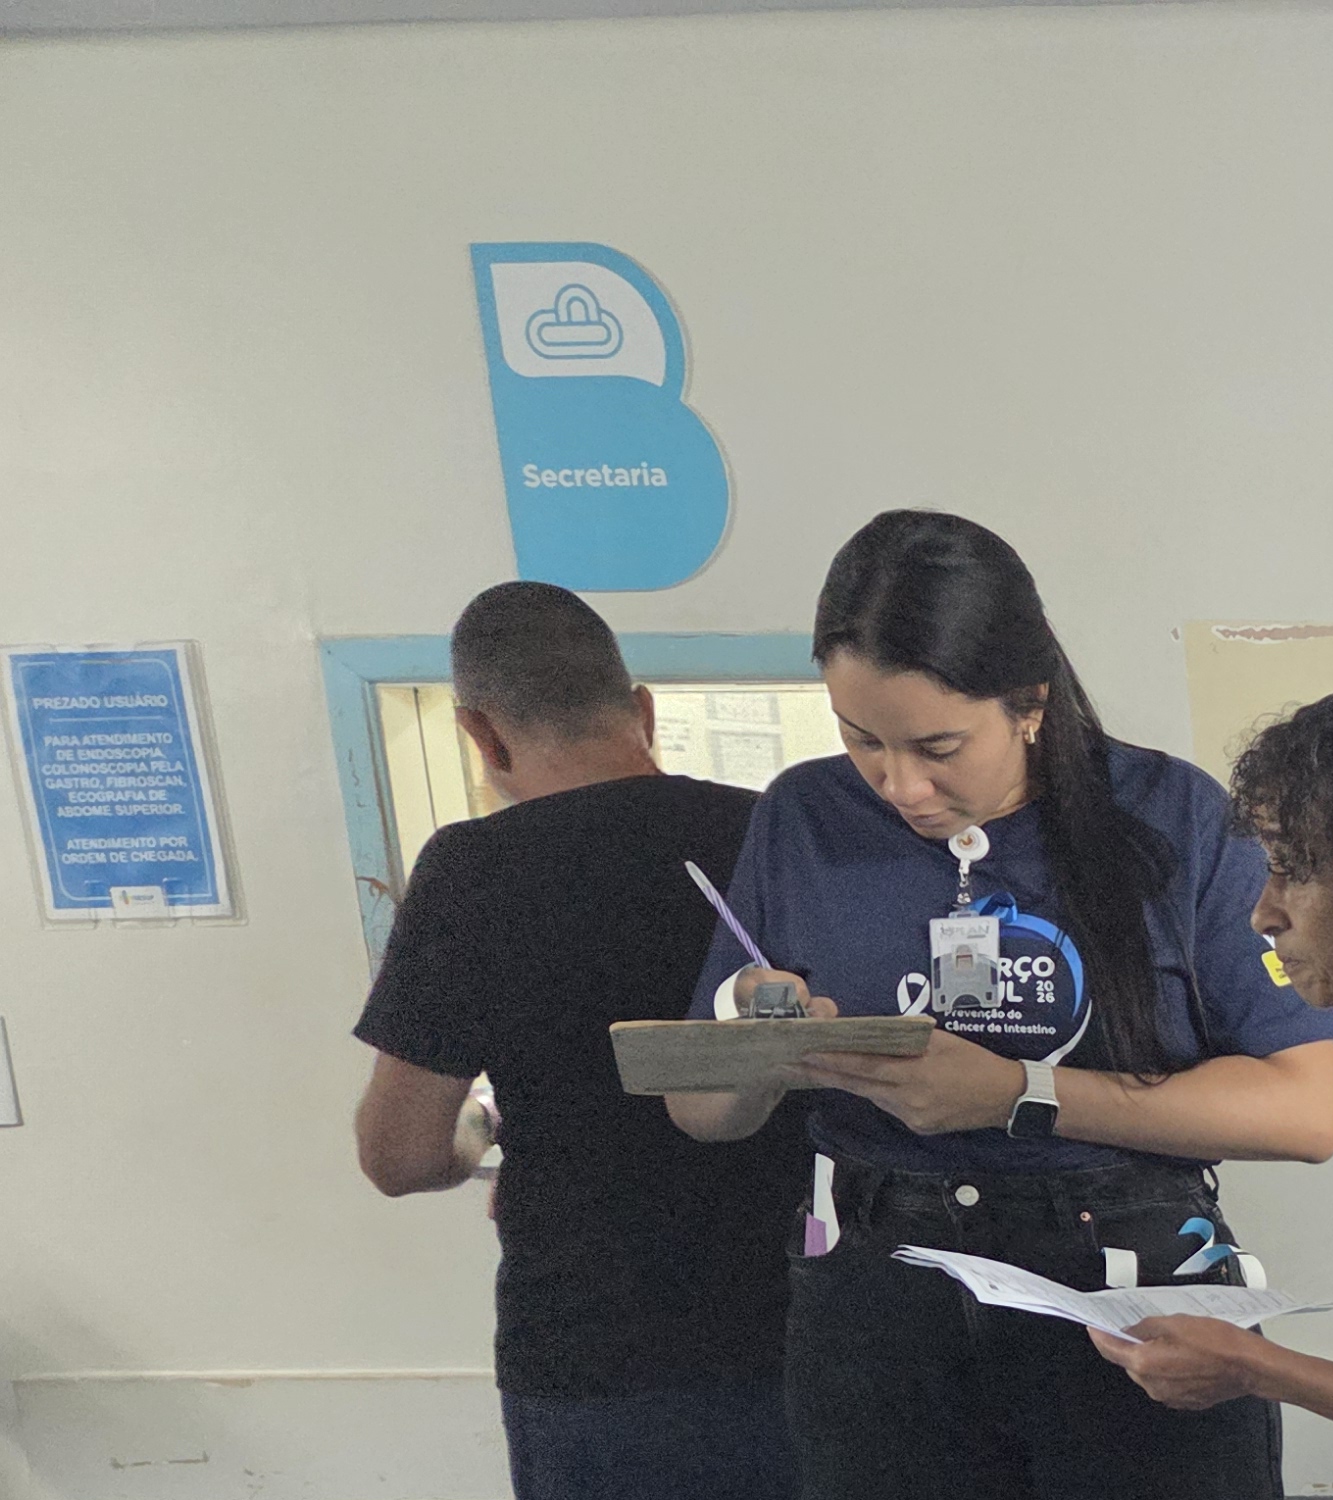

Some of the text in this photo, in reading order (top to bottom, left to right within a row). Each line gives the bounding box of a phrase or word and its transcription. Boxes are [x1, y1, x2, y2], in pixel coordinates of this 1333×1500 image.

[521, 461, 668, 488] Secretaria
[32, 696, 100, 710] PREZADO
[44, 733, 173, 747] PARA ATENDIMENTO
[56, 749, 74, 761] DE
[42, 760, 184, 776] COLONOSCOPIA PELA
[68, 789, 167, 803] ECOGRAFIA DE
[67, 836, 188, 850] ATENDIMENTO POR
[62, 852, 107, 864] ORDEM
[110, 852, 128, 863] DE
[999, 956, 1055, 984] RÇO
[1036, 980, 1054, 992] 20
[1036, 991, 1055, 1003] 26
[945, 1020, 985, 1032] Câncer
[1004, 1023, 1057, 1035] Intestino
